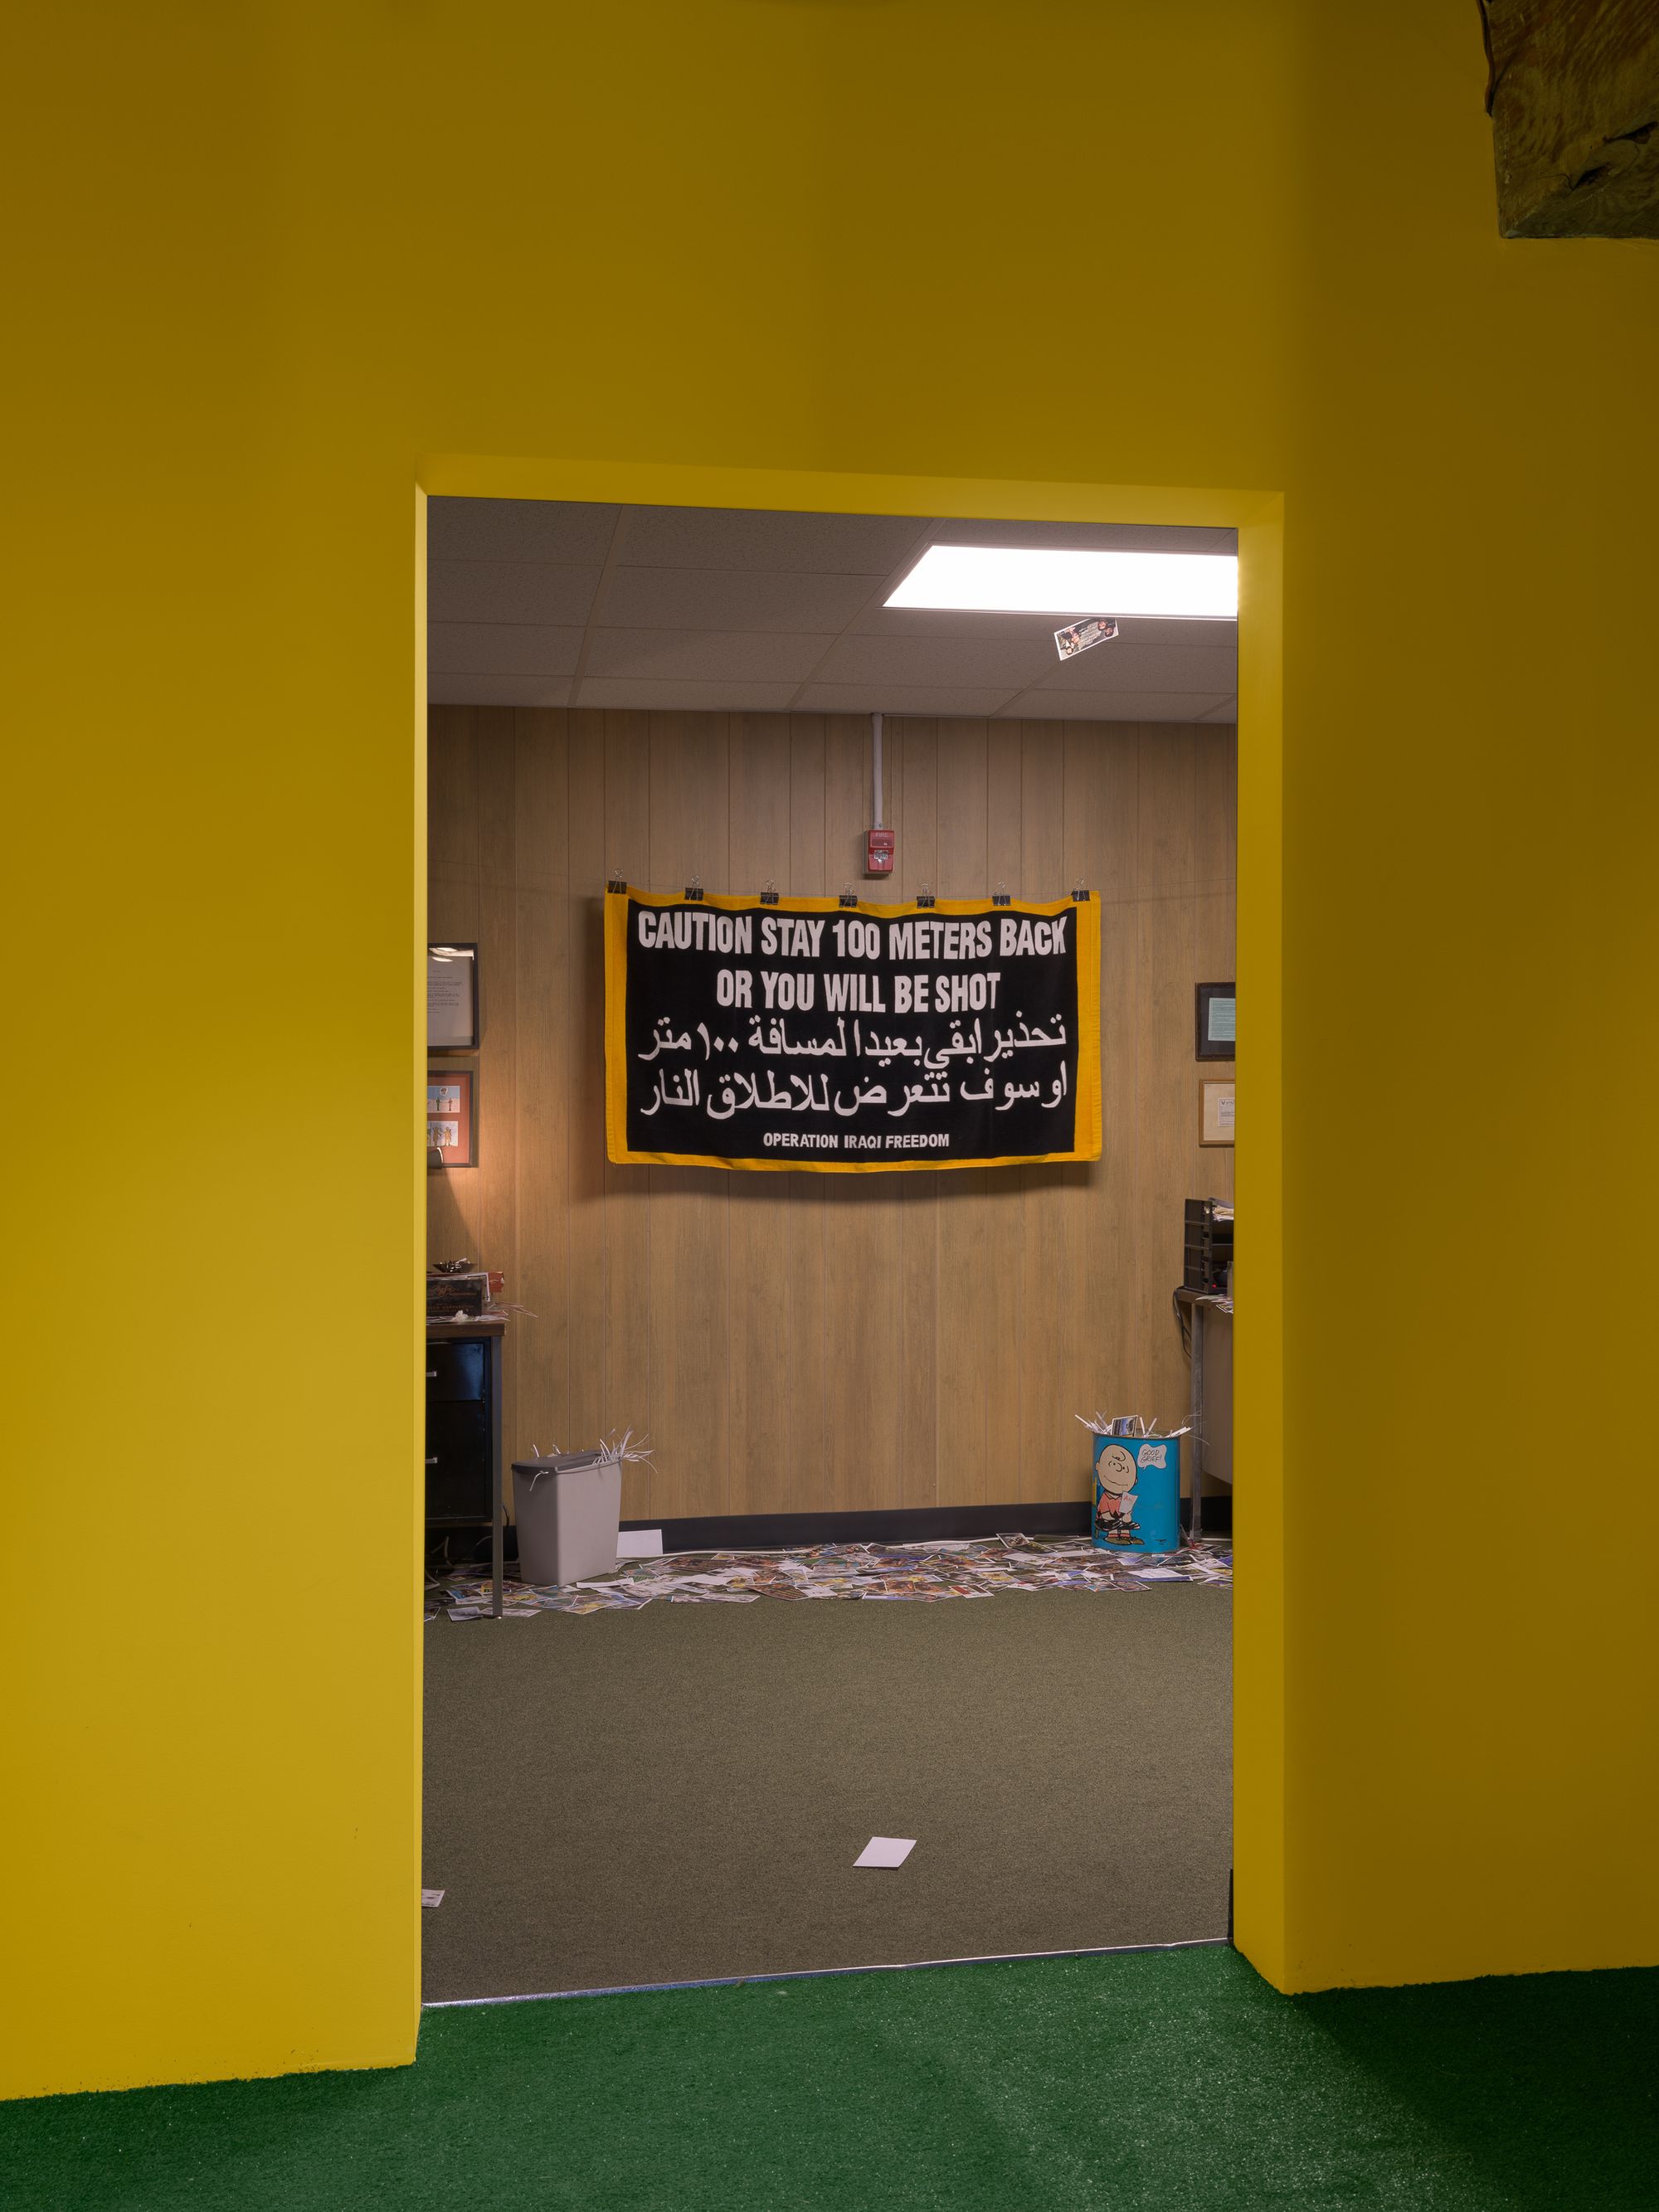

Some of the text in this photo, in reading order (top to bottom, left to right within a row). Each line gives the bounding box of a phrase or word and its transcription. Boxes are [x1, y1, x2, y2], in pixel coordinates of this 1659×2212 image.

[638, 911, 1068, 960] CAUTION STAY 100 METERS BACK
[716, 969, 1001, 1014] OR YOU WILL BE SHOT
[637, 1017, 692, 1061] متر
[983, 1010, 1067, 1062] تحذير
[640, 1068, 700, 1116] النار
[706, 1069, 830, 1120] للاطلاق
[763, 1132, 950, 1150] OPERATION IRAQI FREEDOM
[1141, 1455, 1162, 1463] GRIEF!
